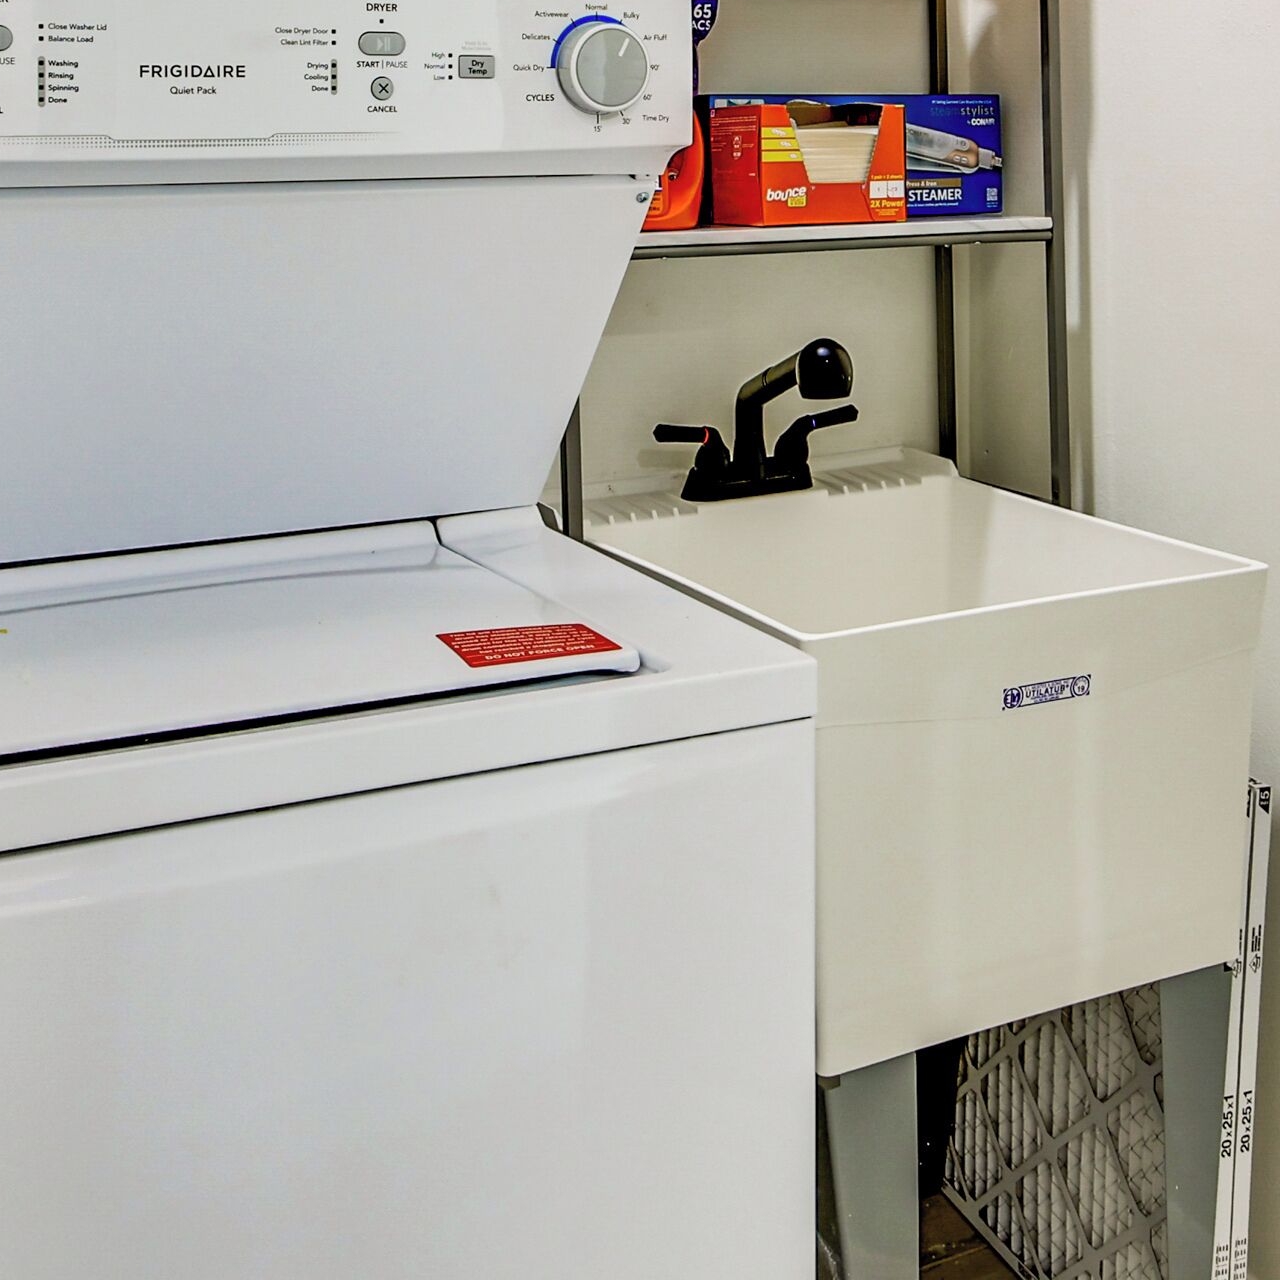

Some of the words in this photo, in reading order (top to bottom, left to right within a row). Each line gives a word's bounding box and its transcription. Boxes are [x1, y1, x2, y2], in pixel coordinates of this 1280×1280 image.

[366, 3, 398, 12] DRYER
[693, 3, 712, 19] 65
[623, 11, 640, 20] Bulky
[48, 22, 68, 30] Close
[293, 27, 311, 35] Dryer
[521, 33, 551, 41] Delicates
[280, 38, 298, 46] Clean
[47, 60, 79, 68] Washing
[307, 62, 329, 70] Drying
[356, 60, 380, 69] START
[385, 60, 408, 69] PAUSE
[471, 59, 485, 68] Dry
[139, 65, 247, 78] FRIGIDAIRE
[468, 67, 488, 75] Temp
[513, 64, 532, 72] Quick
[532, 64, 545, 73] Dry
[47, 72, 74, 81] Rinsing
[304, 73, 329, 82] Cooling
[47, 84, 80, 93] Spinning
[169, 85, 195, 96] Quiet
[197, 85, 217, 95] Pack
[525, 94, 555, 102] CYCLES
[367, 105, 398, 114] CANCEL
[960, 105, 995, 117] stylist
[642, 114, 657, 122] Time
[658, 115, 670, 123] Dry
[970, 118, 996, 126] CONAIR
[766, 186, 807, 201] bounce
[908, 188, 963, 202] STEAMER
[870, 200, 881, 209] 2X
[881, 199, 904, 208] Power
[503, 650, 525, 658] NOT
[528, 646, 564, 655] FORCE
[565, 643, 595, 651] OPEN
[1260, 790, 1270, 799] 5
